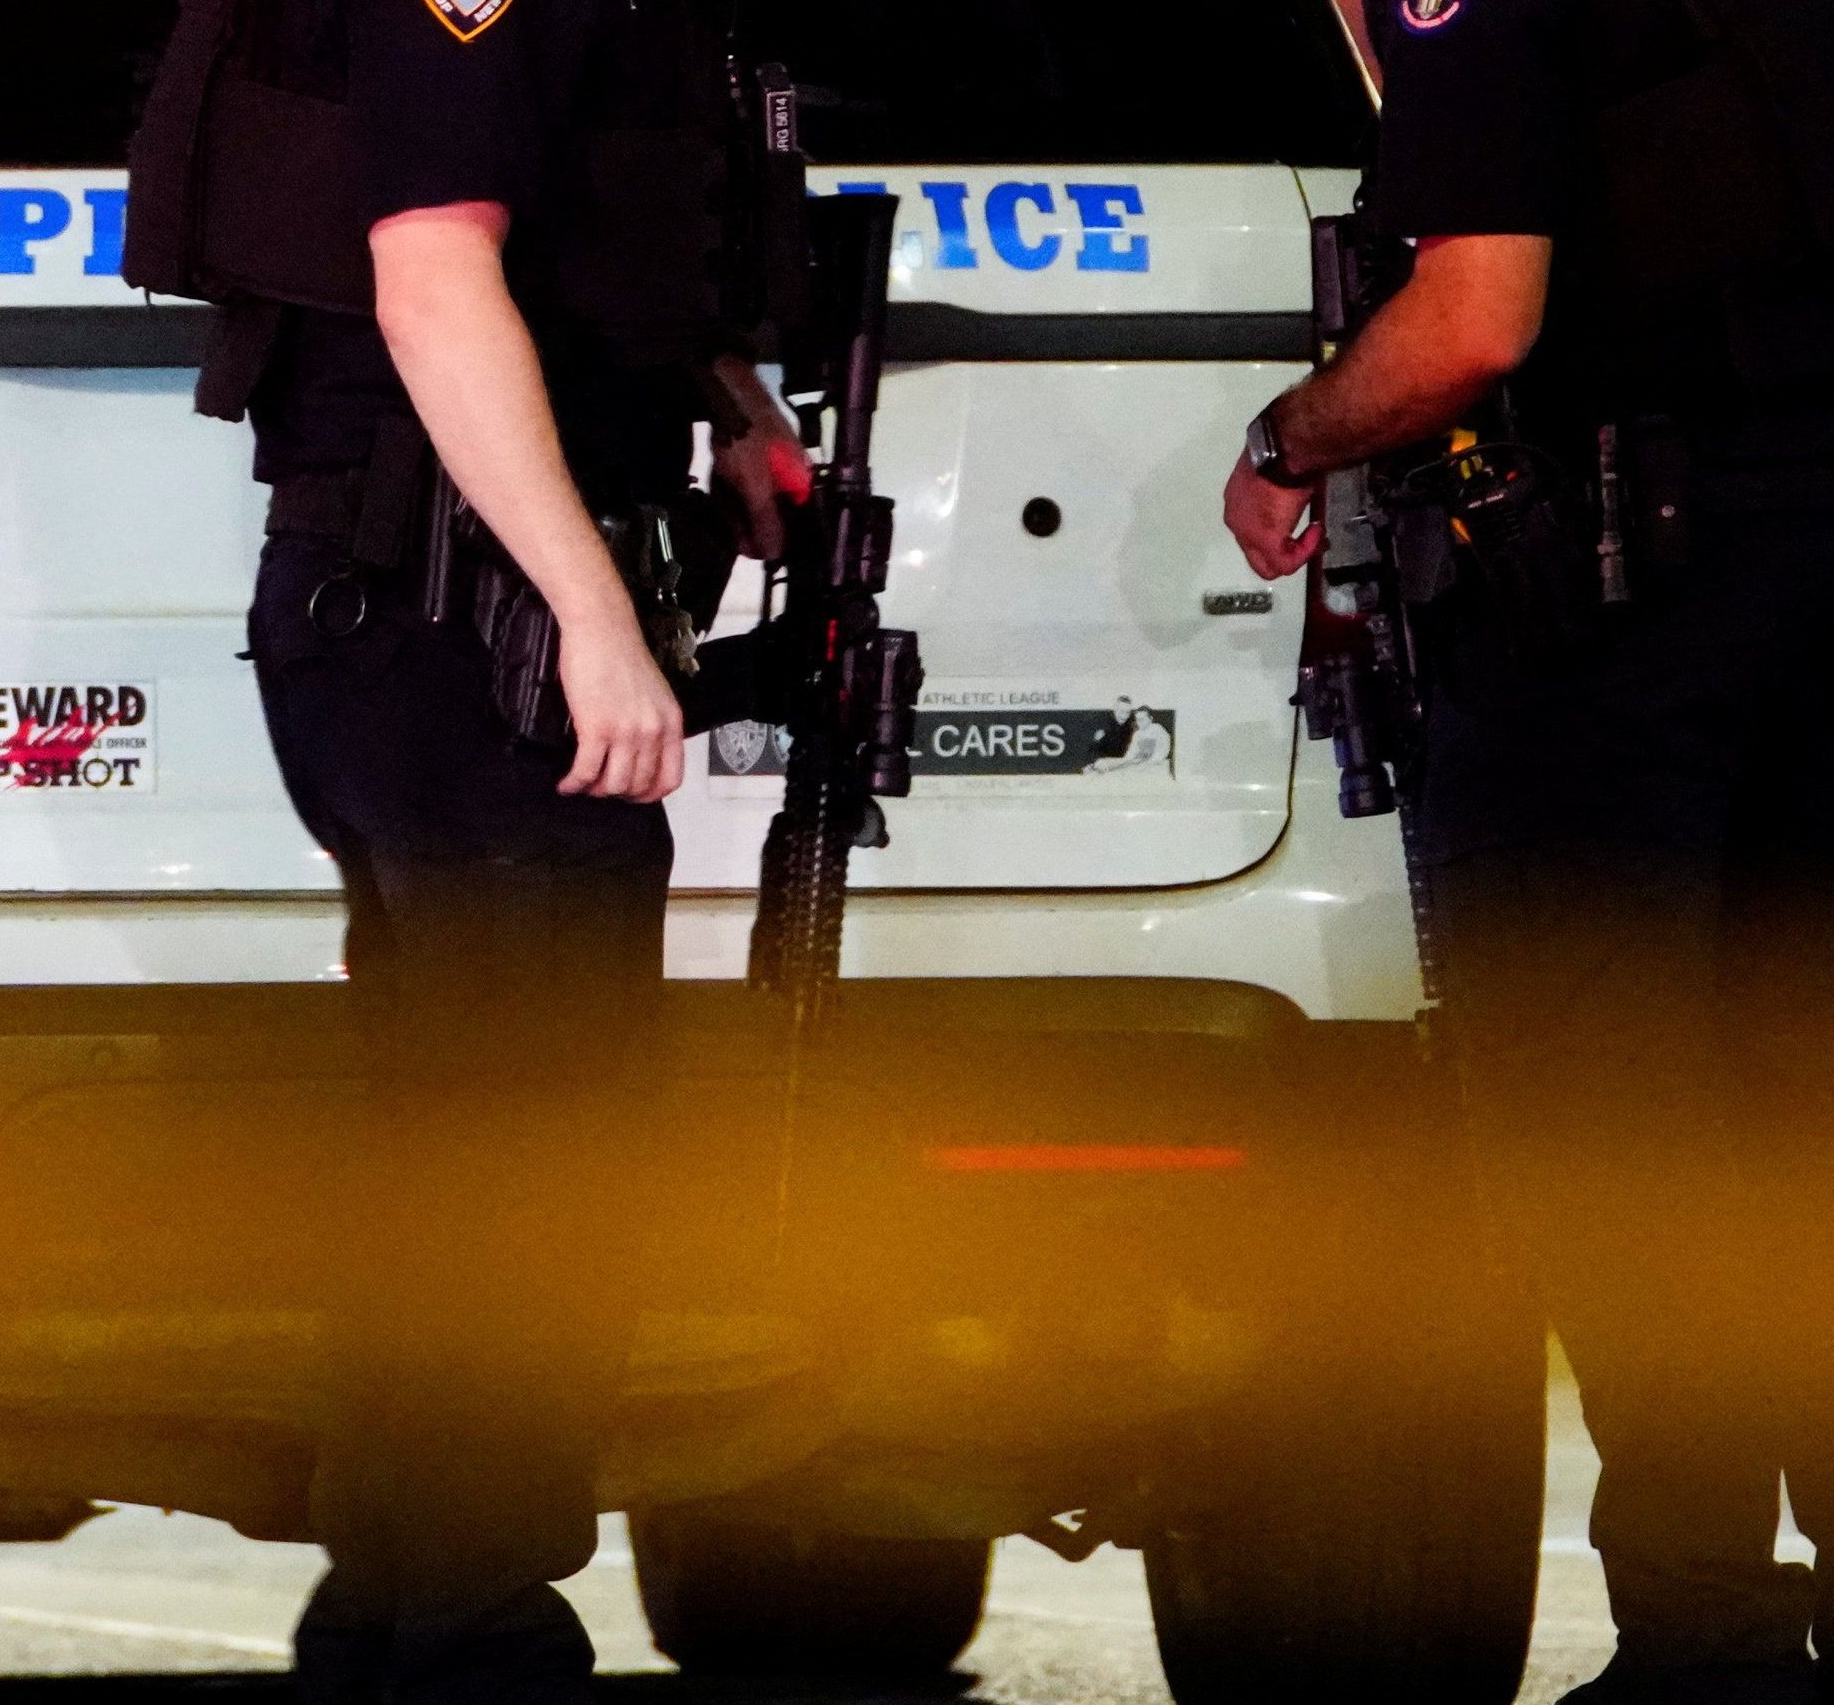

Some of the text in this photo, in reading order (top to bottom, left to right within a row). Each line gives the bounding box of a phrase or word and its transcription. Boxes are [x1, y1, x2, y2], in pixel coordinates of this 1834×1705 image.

[922, 692, 1059, 705] ATHLETIC LEAGUE
[933, 723, 1066, 757] CARES
